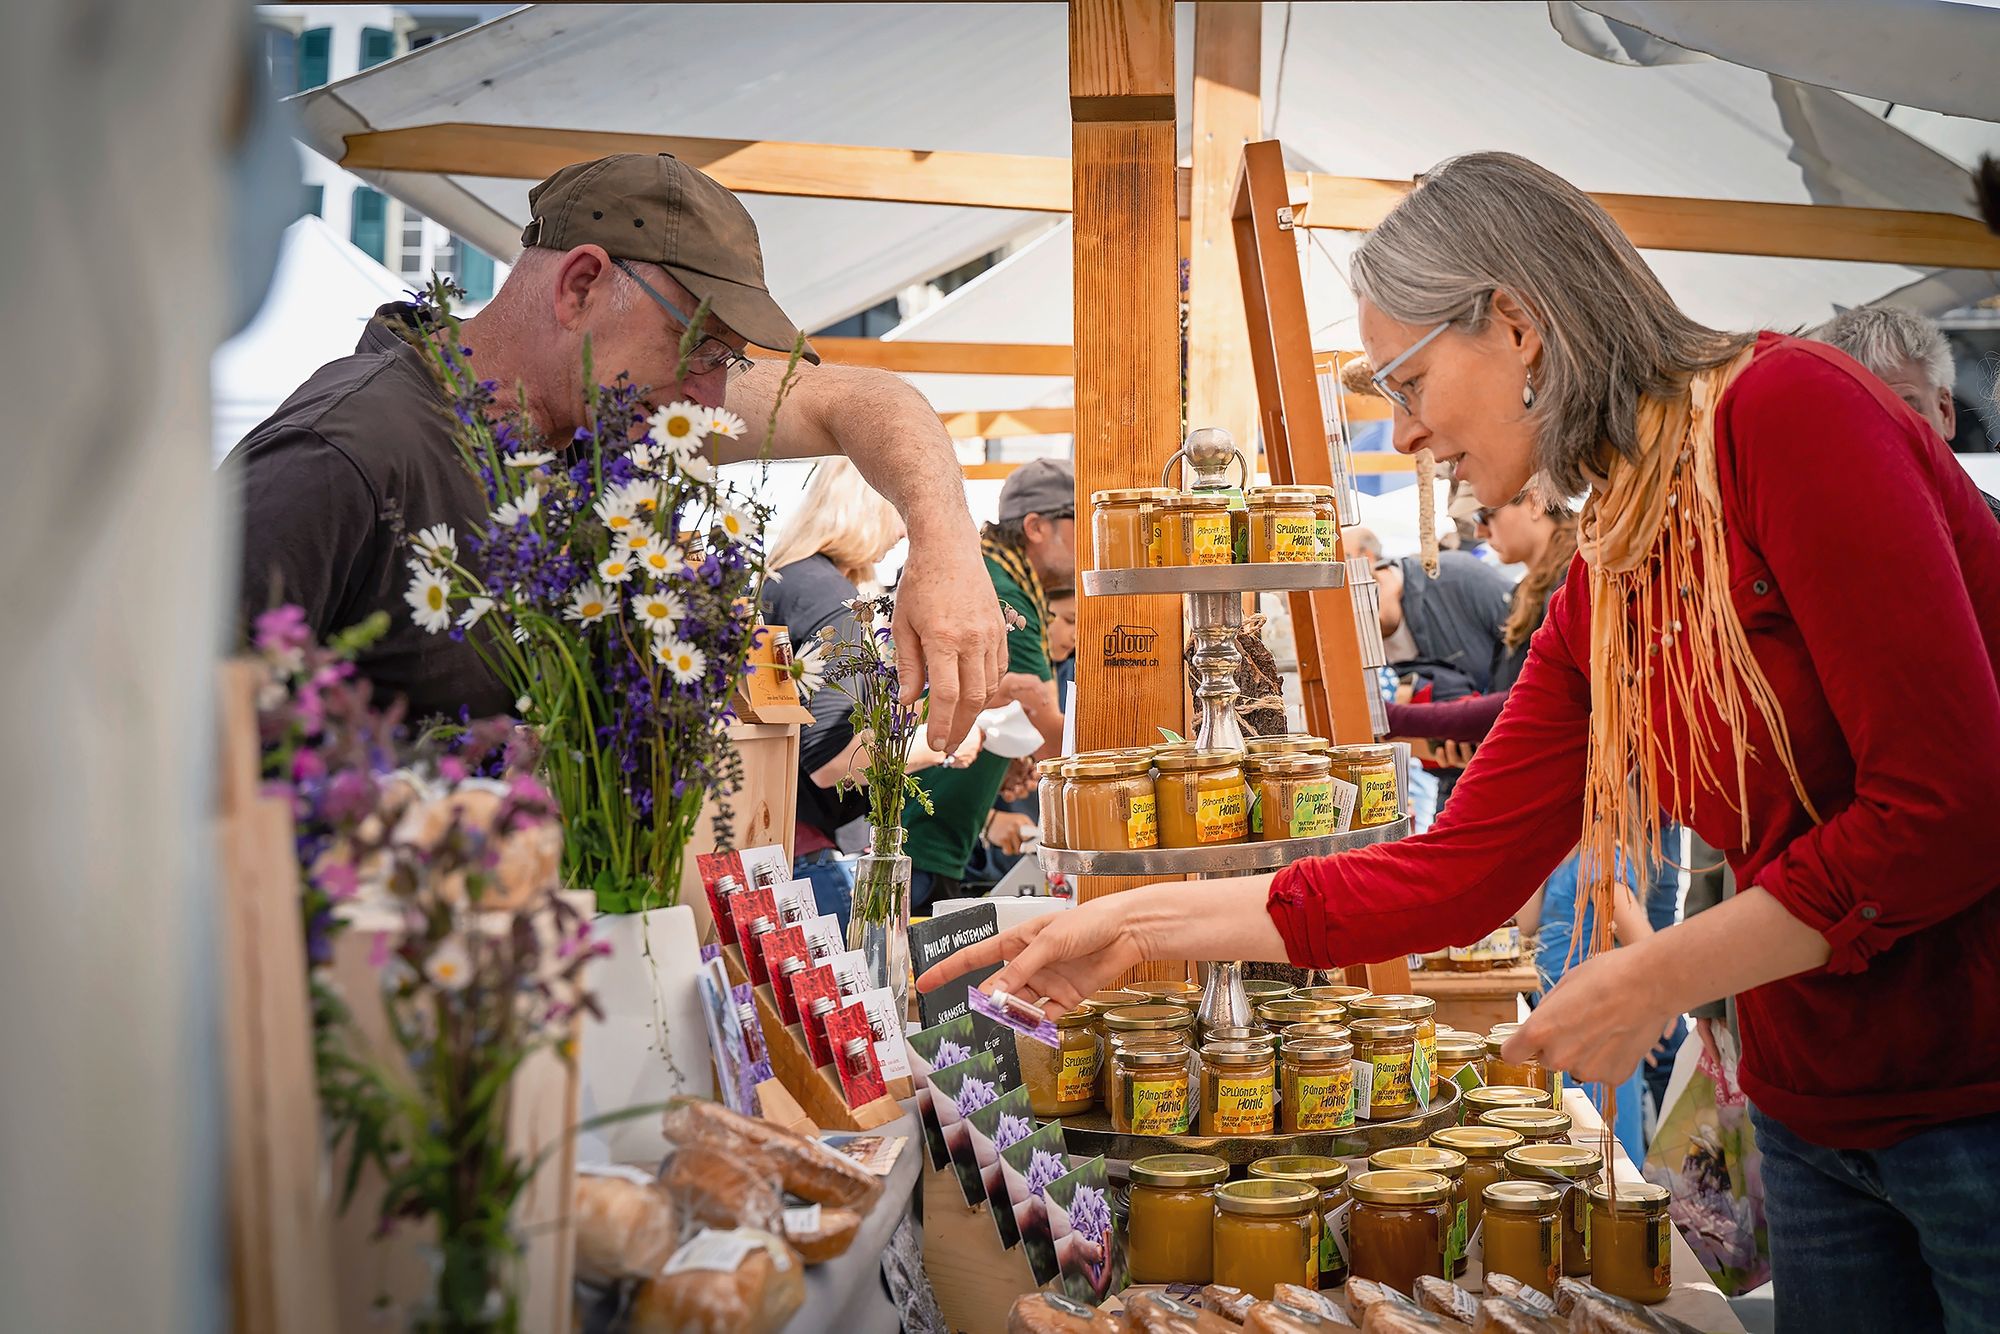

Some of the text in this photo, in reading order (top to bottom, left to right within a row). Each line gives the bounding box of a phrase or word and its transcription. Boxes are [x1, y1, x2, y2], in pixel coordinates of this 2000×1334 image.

[1276, 523, 1309, 534] SPLÜGNER
[1291, 535, 1312, 546] HONIG
[1104, 626, 1154, 656] gloor
[1295, 792, 1328, 810] BÜNDNER
[1219, 803, 1241, 816] HONIG
[924, 921, 994, 962] PHILIPP WÜSTEMANN
[1374, 1062, 1407, 1080] BÜNDNER
[1220, 1085, 1258, 1097] SPLÜGNER
[1300, 1084, 1337, 1104] BÜNDNER
[1136, 1089, 1173, 1109] BÜNDNER
[1156, 1100, 1181, 1113] HONIG
[1236, 1095, 1264, 1110] HONIG
[1320, 1093, 1346, 1108] HONIG
